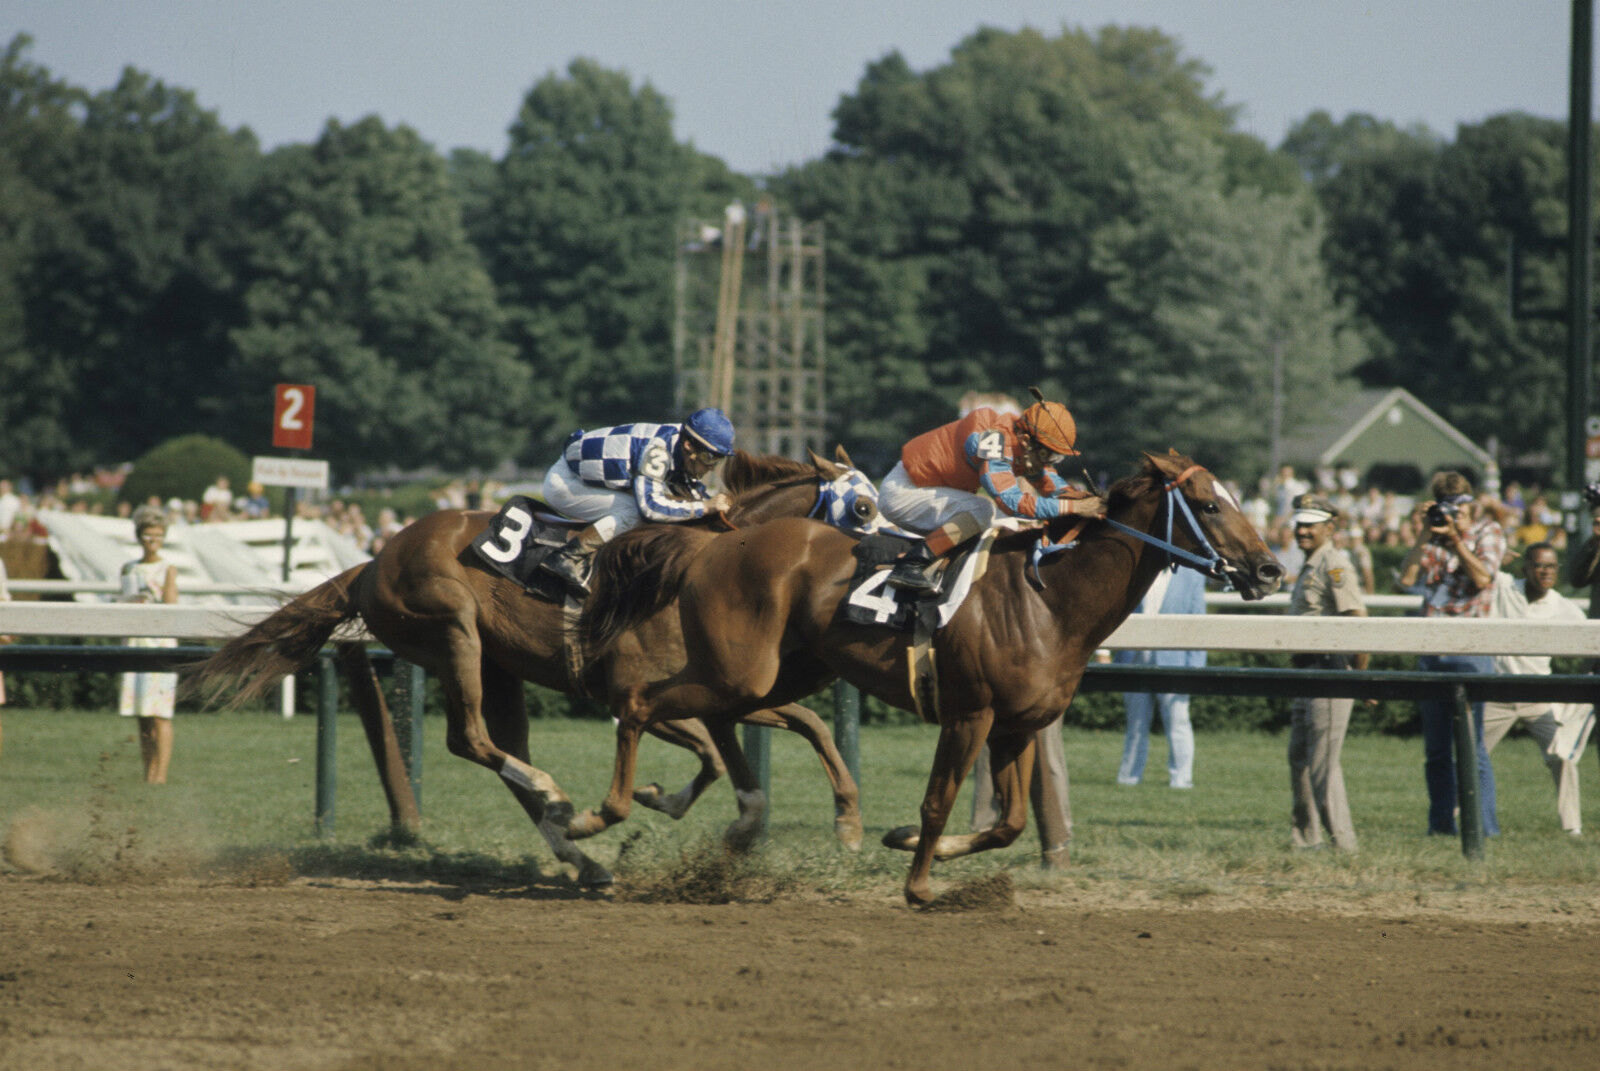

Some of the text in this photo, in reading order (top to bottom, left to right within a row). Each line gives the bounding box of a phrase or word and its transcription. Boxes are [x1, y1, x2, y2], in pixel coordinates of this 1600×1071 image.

[279, 388, 304, 430] 2
[644, 446, 671, 479] 3
[978, 432, 1003, 459] 4
[480, 506, 533, 563] 3
[848, 569, 899, 623] 4
